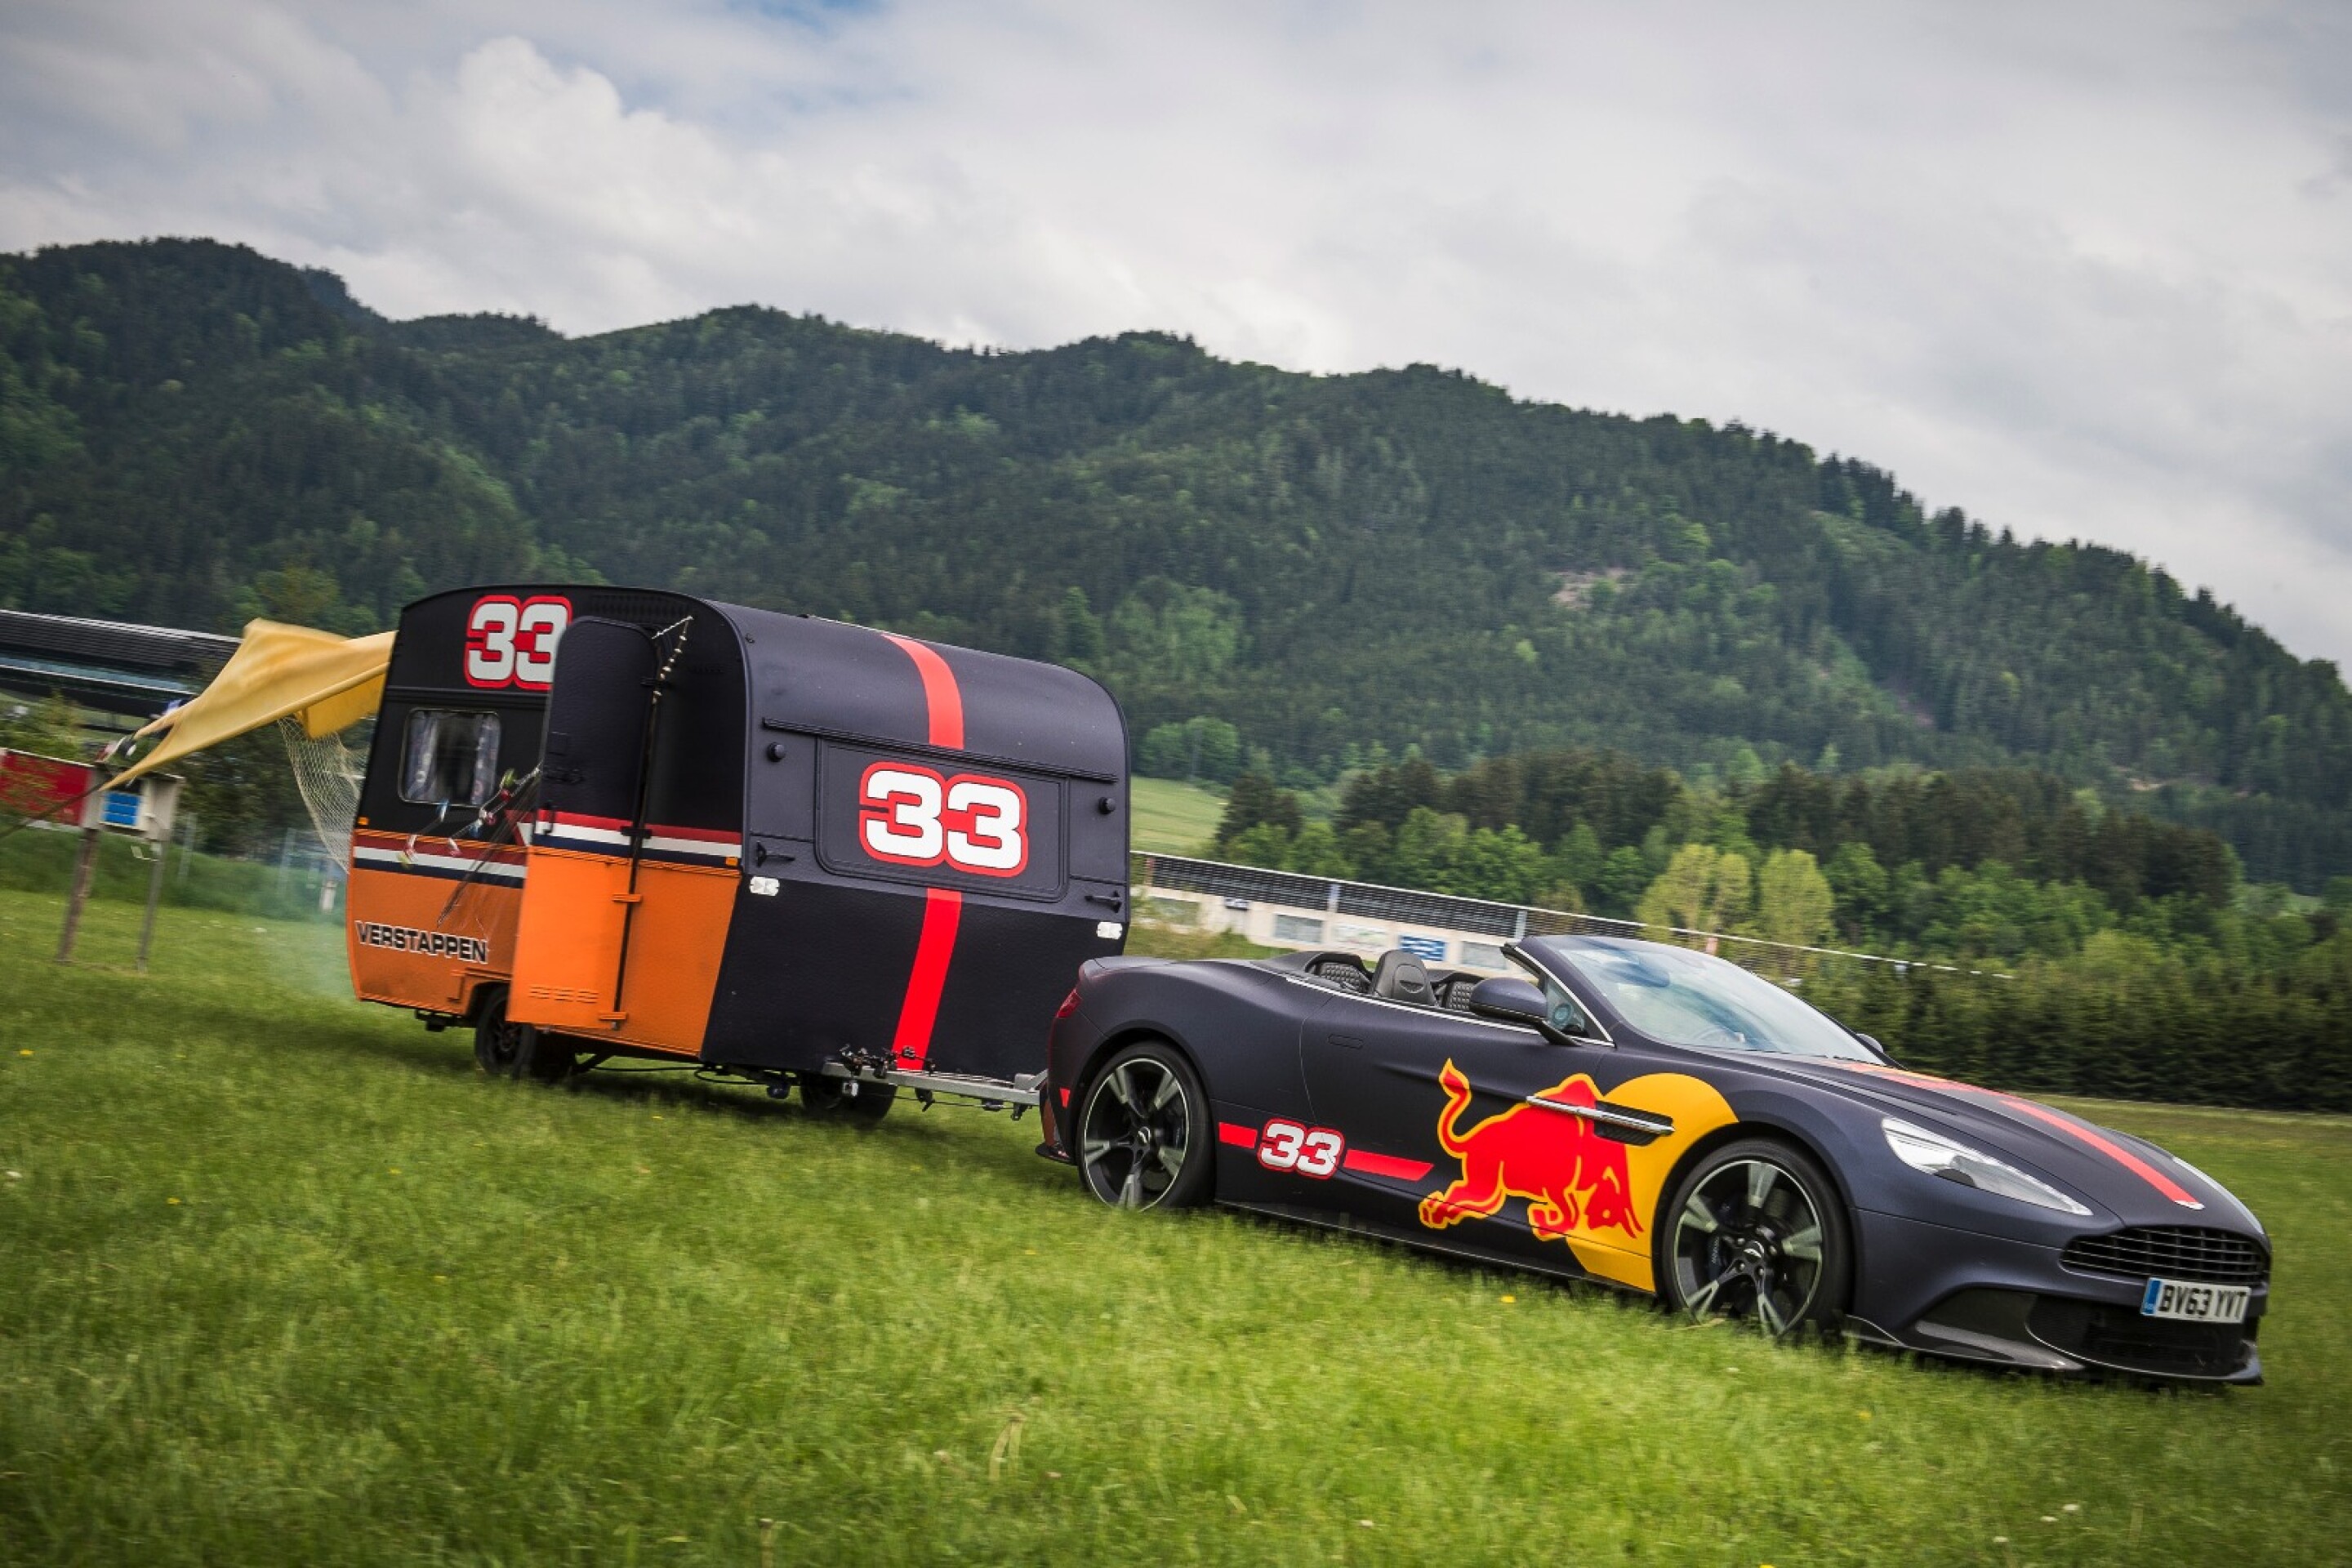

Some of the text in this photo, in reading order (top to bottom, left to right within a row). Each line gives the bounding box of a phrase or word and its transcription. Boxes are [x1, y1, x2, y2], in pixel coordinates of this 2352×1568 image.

[467, 602, 568, 684] 33
[864, 768, 1022, 871] 33
[354, 920, 489, 964] VERSTAPPEN
[1260, 1122, 1342, 1176] 33
[2158, 1285, 2212, 1315] BV63
